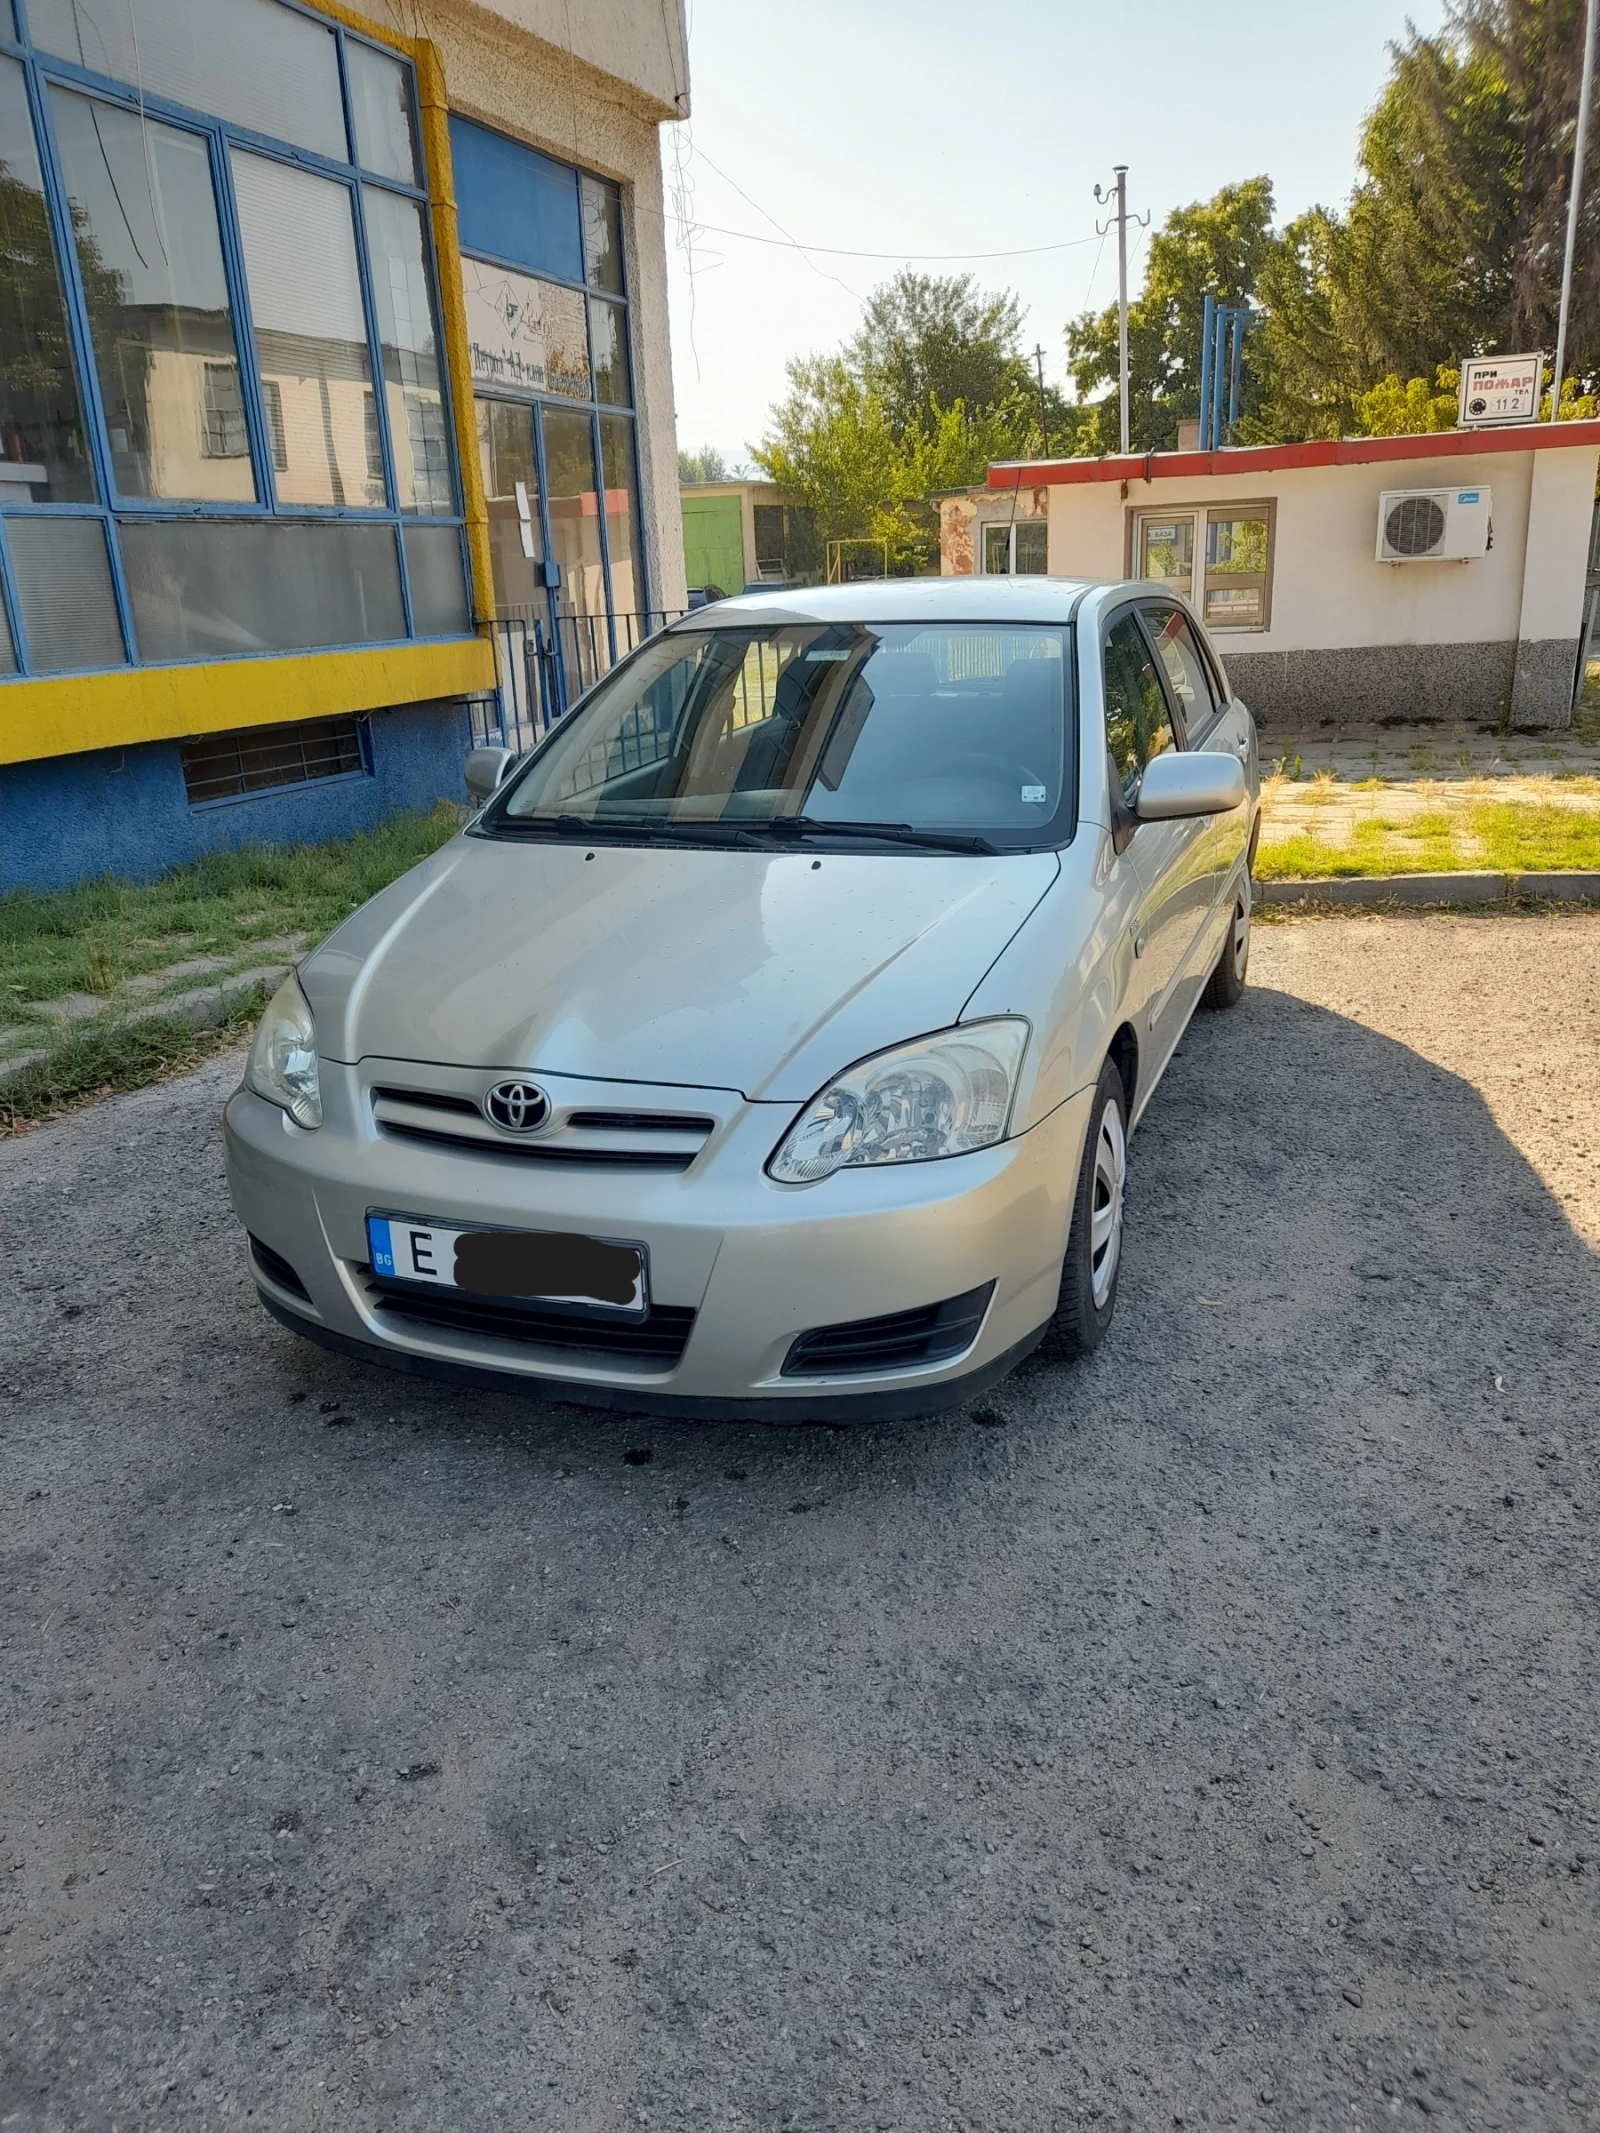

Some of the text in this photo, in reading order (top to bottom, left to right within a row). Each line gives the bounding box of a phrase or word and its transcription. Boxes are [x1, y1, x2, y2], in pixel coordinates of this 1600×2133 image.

[1474, 371, 1497, 379] ПРИ
[1473, 377, 1533, 391] ПОЖАР
[376, 1252, 392, 1266] BG
